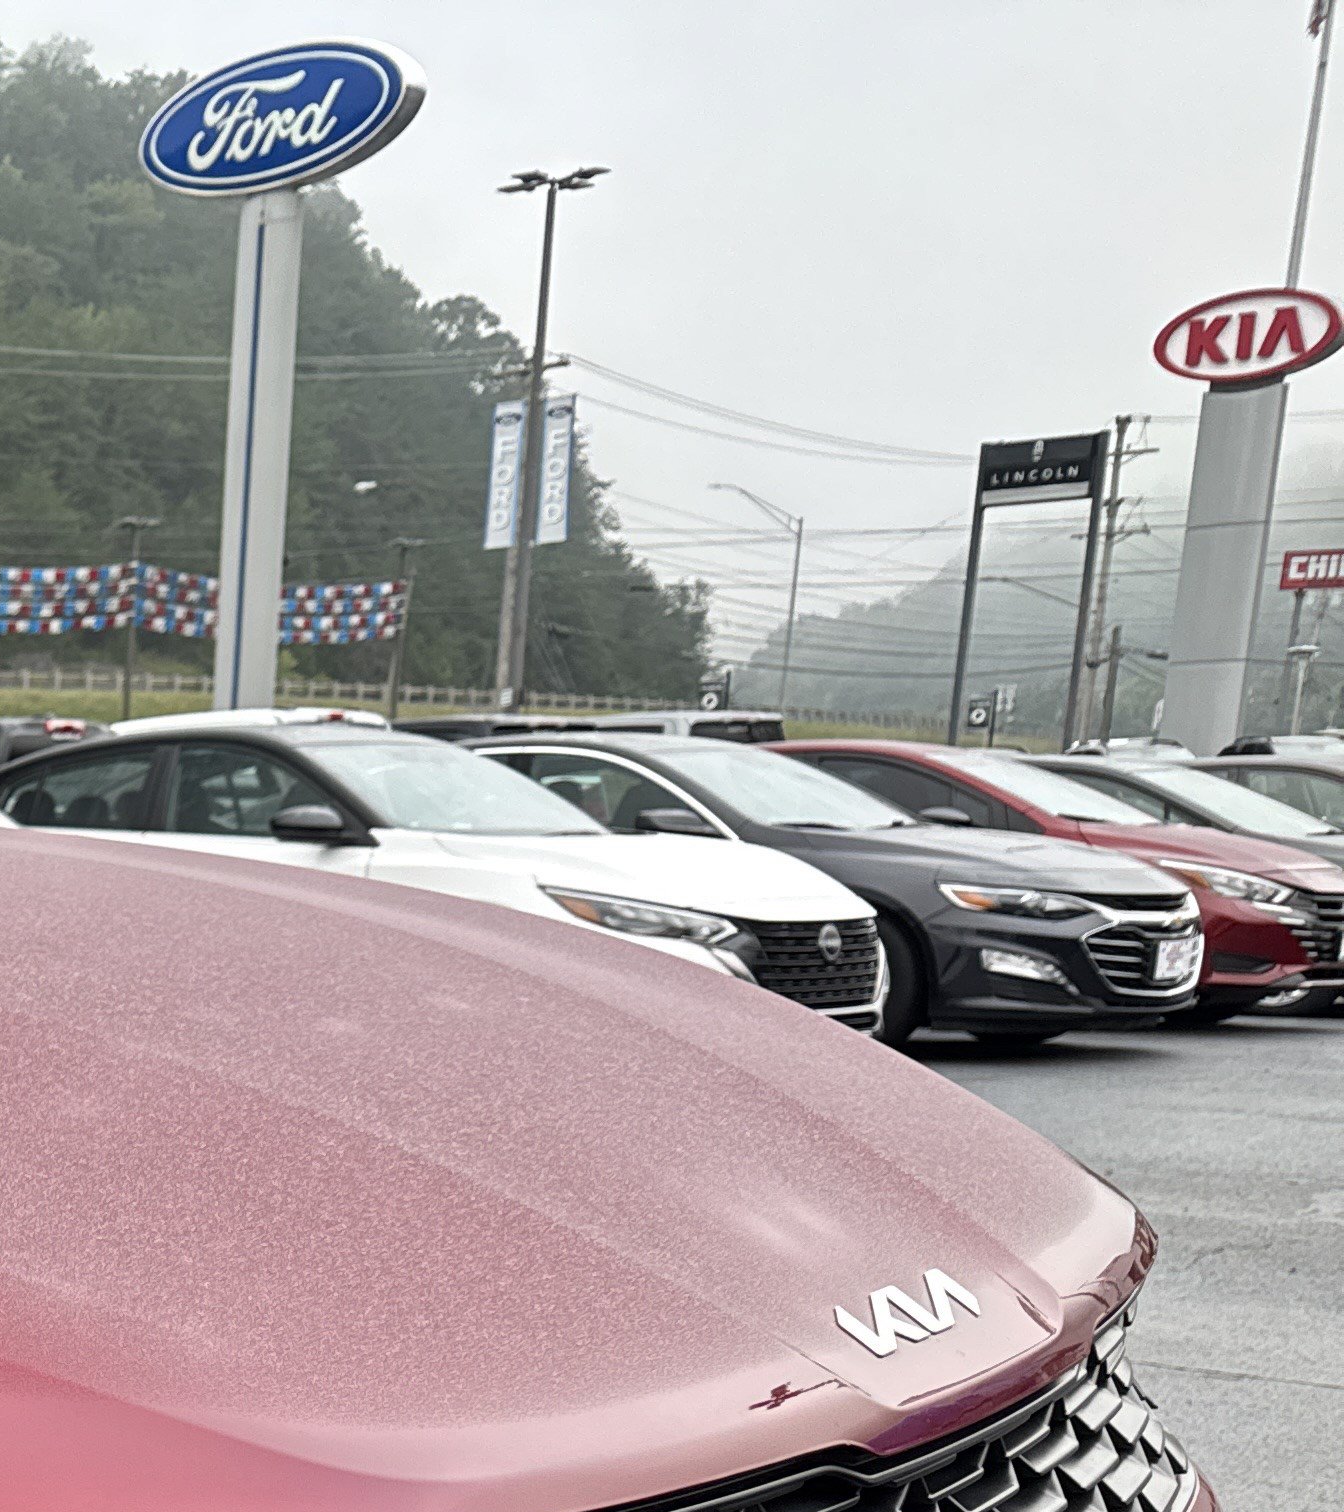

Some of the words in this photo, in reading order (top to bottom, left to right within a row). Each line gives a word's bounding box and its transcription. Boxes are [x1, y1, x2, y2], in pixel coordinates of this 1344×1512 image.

[186, 68, 345, 173] Ford
[1185, 305, 1305, 369] KIA
[489, 434, 518, 533] FORD
[544, 428, 571, 527] FORD
[990, 464, 1080, 488] LINCOLN
[1288, 553, 1344, 580] CHI
[833, 1267, 981, 1358] KIA
